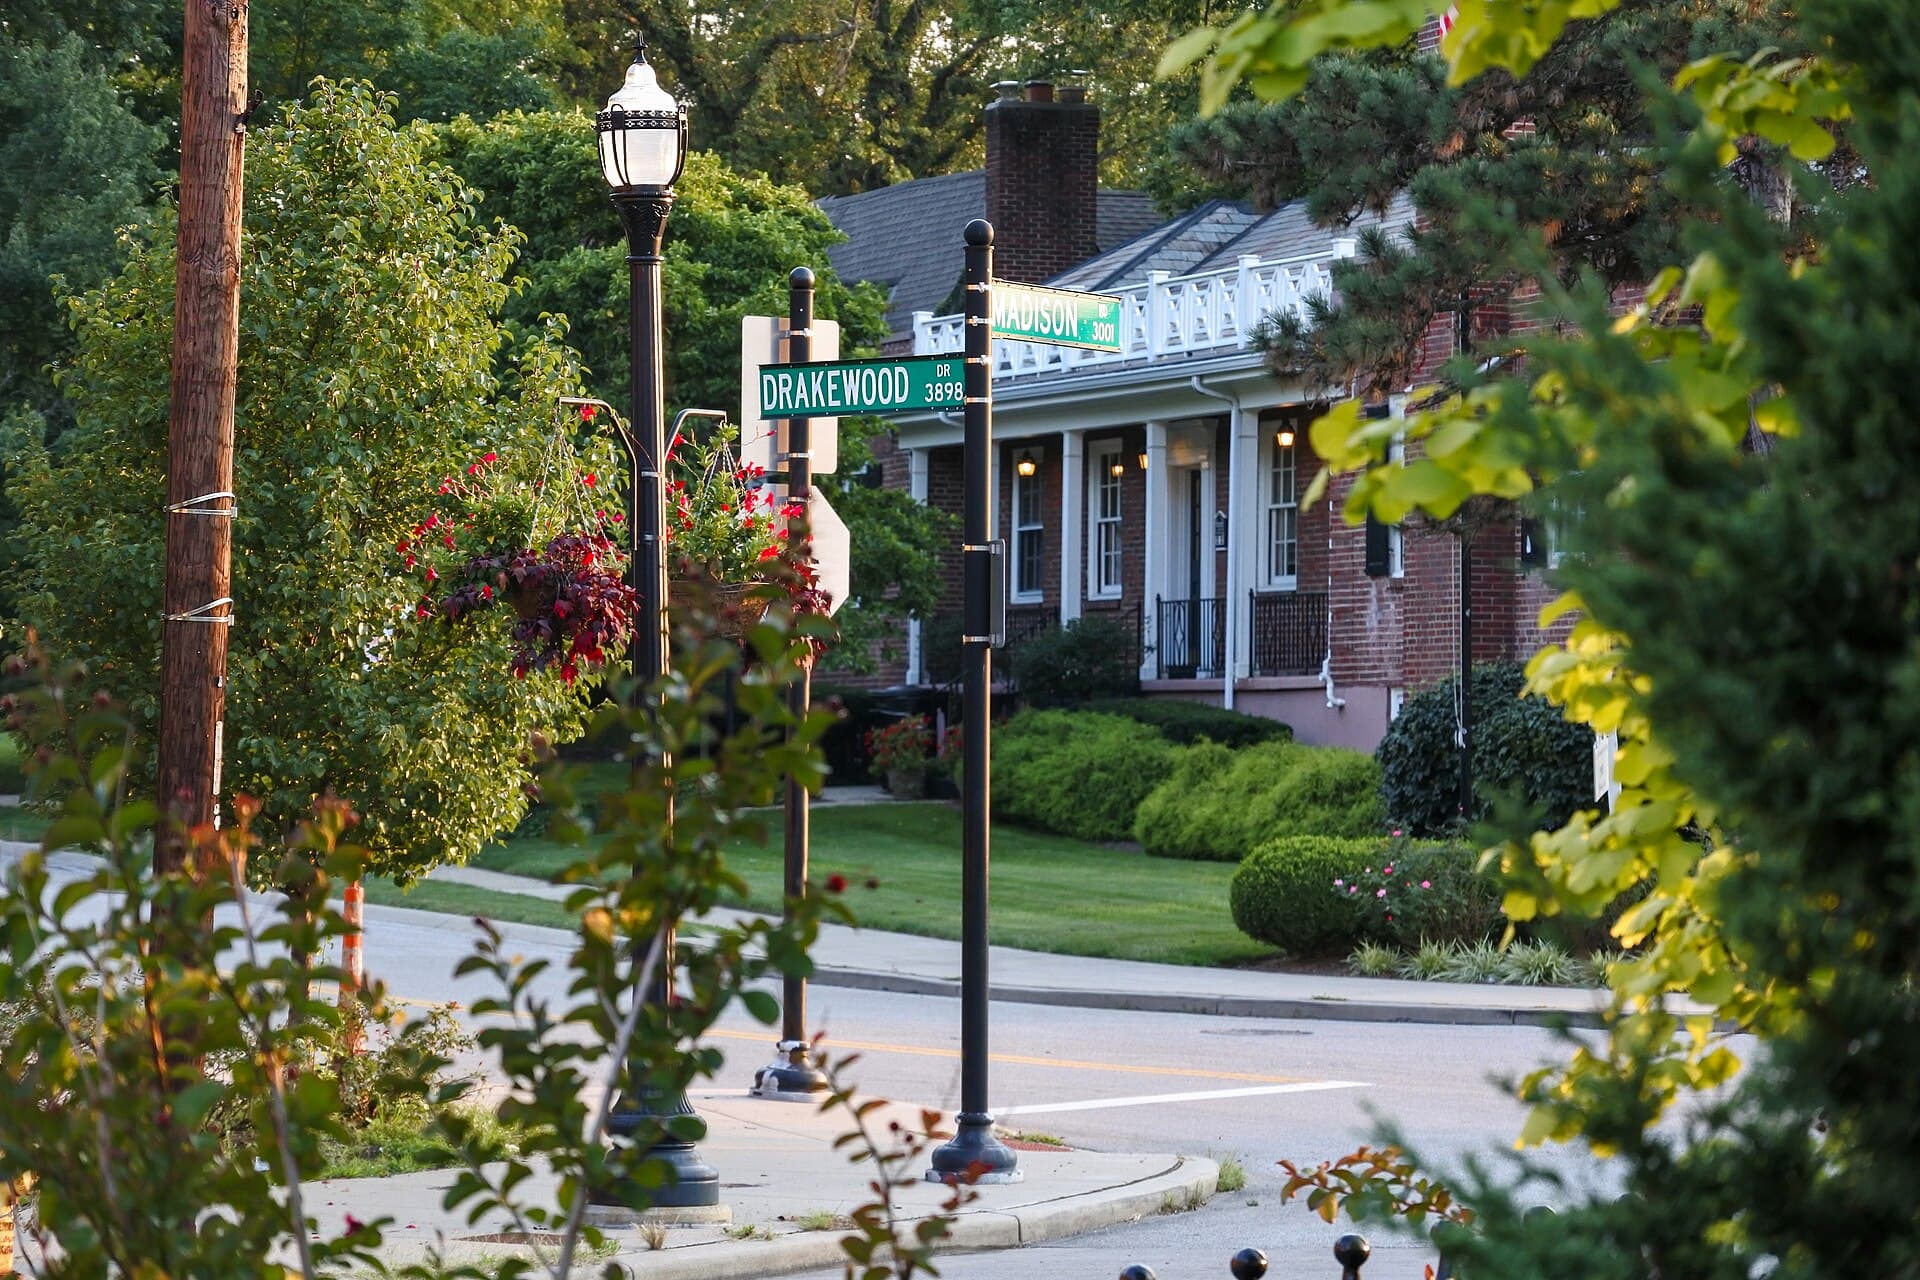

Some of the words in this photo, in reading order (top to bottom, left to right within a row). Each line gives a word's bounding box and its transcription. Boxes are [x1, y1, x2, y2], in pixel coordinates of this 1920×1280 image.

[992, 290, 1078, 337] MADISON
[1092, 321, 1115, 343] 3001
[762, 366, 909, 411] DRAKEWOOD
[936, 363, 951, 378] DR
[924, 381, 964, 403] 3898
